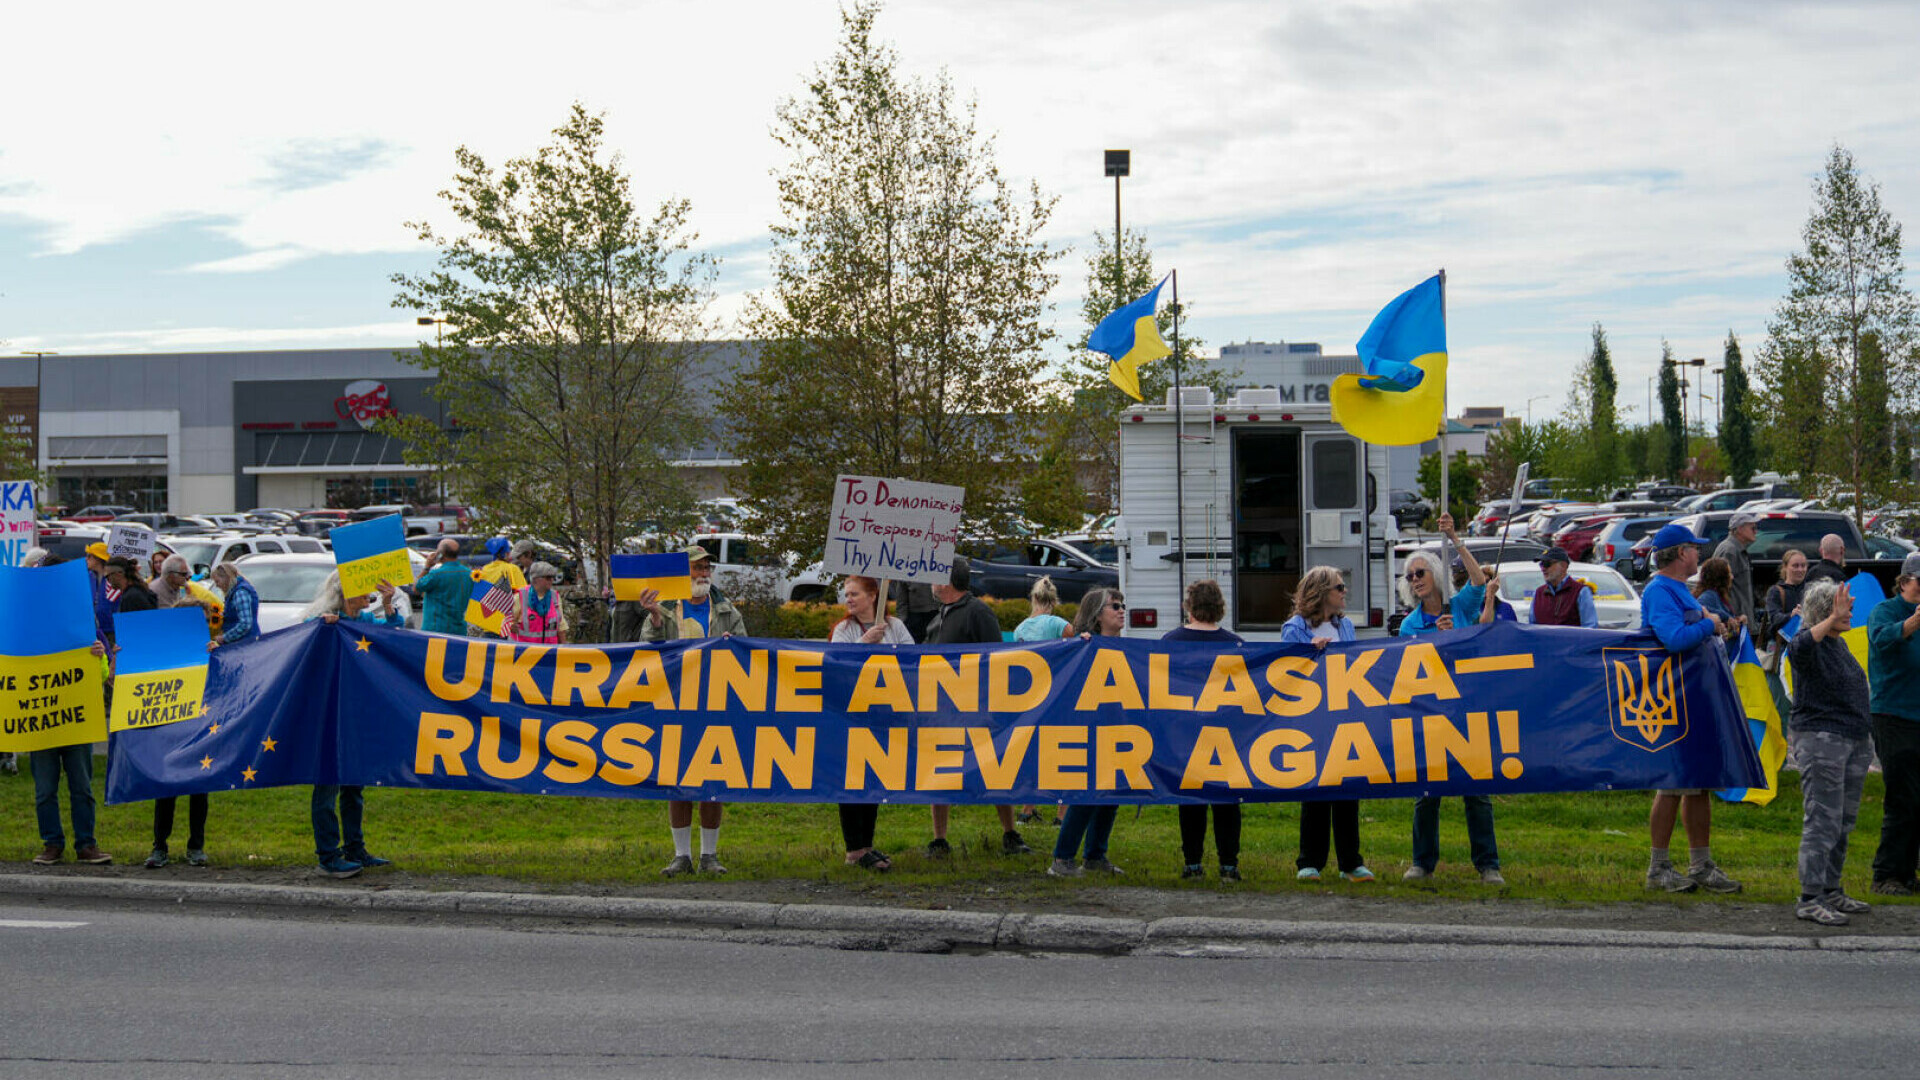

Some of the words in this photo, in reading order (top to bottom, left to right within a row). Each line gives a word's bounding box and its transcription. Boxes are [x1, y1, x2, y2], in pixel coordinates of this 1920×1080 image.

[0, 482, 34, 510] KA
[841, 478, 868, 505] To
[949, 499, 962, 514] is
[9, 520, 34, 533] WITH
[838, 508, 856, 533] to
[345, 560, 381, 577] STAND
[386, 554, 409, 569] WITH
[834, 537, 872, 574] Thy
[878, 541, 954, 577] Neighbor
[28, 667, 84, 691] STAND
[132, 678, 184, 697] STAND
[424, 637, 823, 712] UKRAINE
[846, 649, 1052, 713] AND
[18, 694, 58, 710] WITH
[142, 692, 178, 708] WITH
[4, 705, 86, 734] UKRAINE
[127, 700, 196, 726] UKRAINE
[414, 711, 816, 790] RUSSIAN
[844, 724, 1154, 791] NEVER
[1179, 710, 1524, 790] AGAIN!
